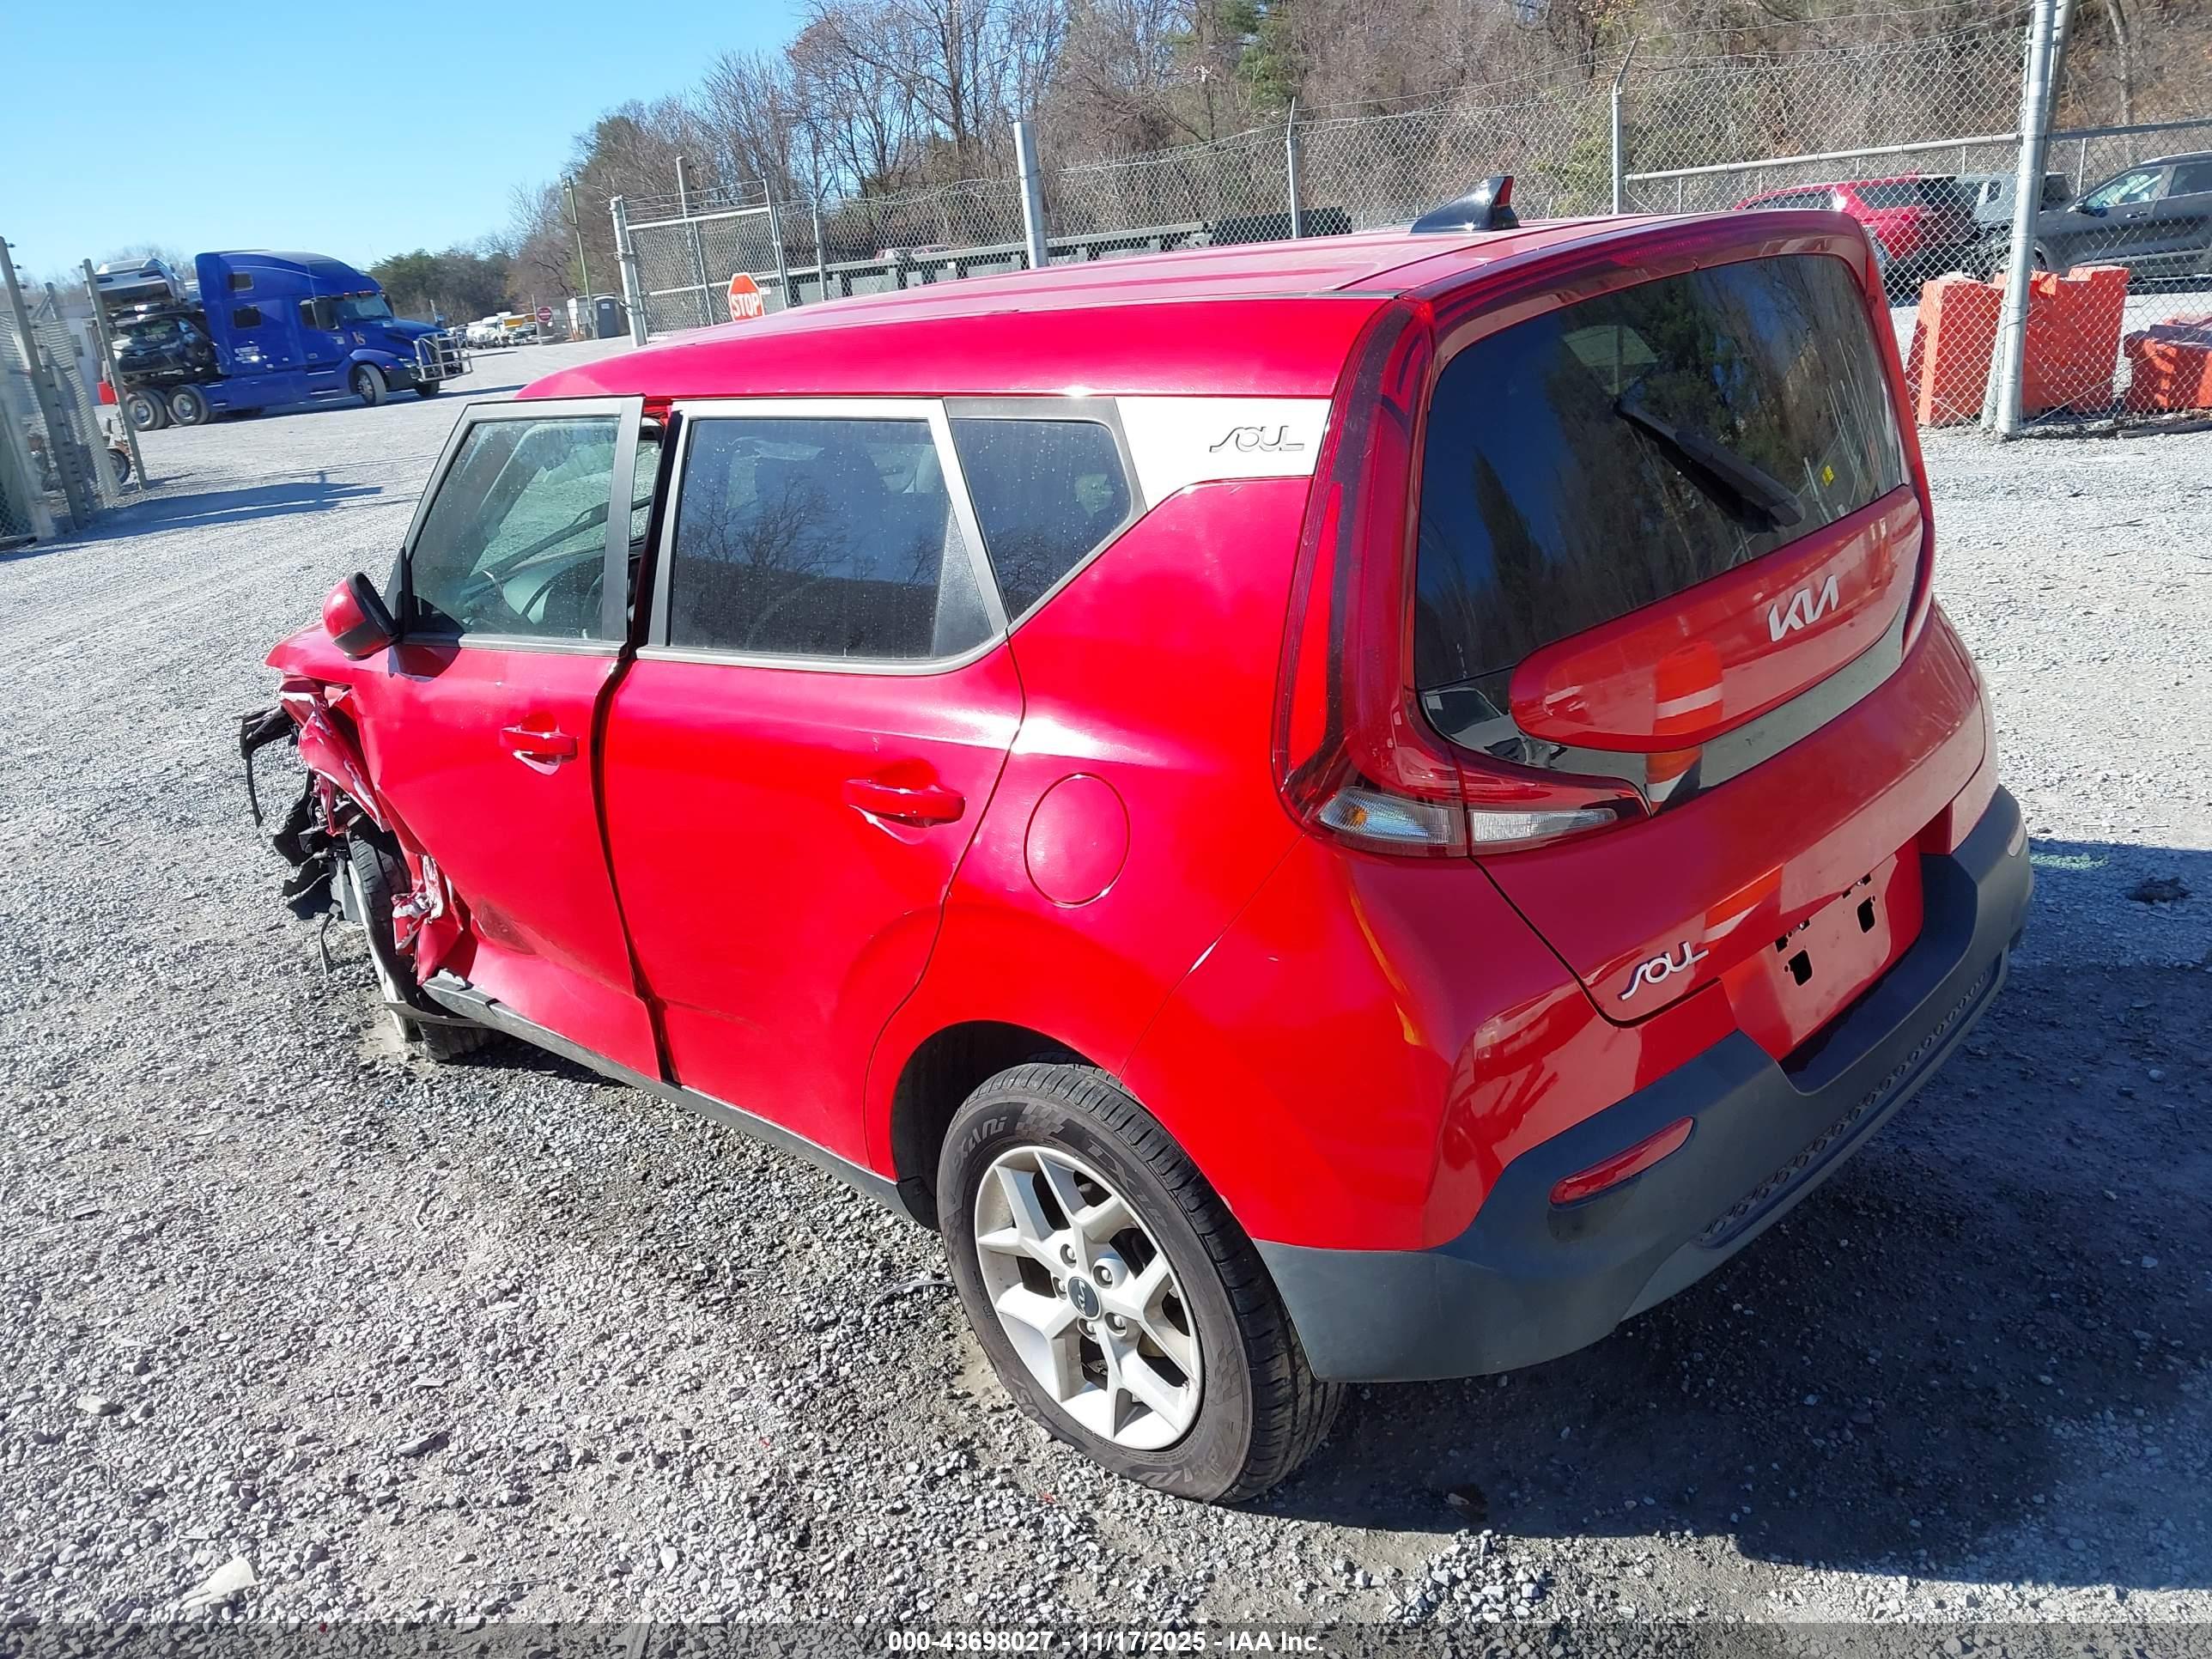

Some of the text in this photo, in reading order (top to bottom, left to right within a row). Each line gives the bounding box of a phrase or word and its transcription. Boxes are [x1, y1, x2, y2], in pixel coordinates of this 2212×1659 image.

[731, 293, 760, 317] STOP
[1209, 426, 1304, 453] SOUL
[1767, 574, 1839, 642] KIA
[1619, 941, 1710, 1000] SOUL
